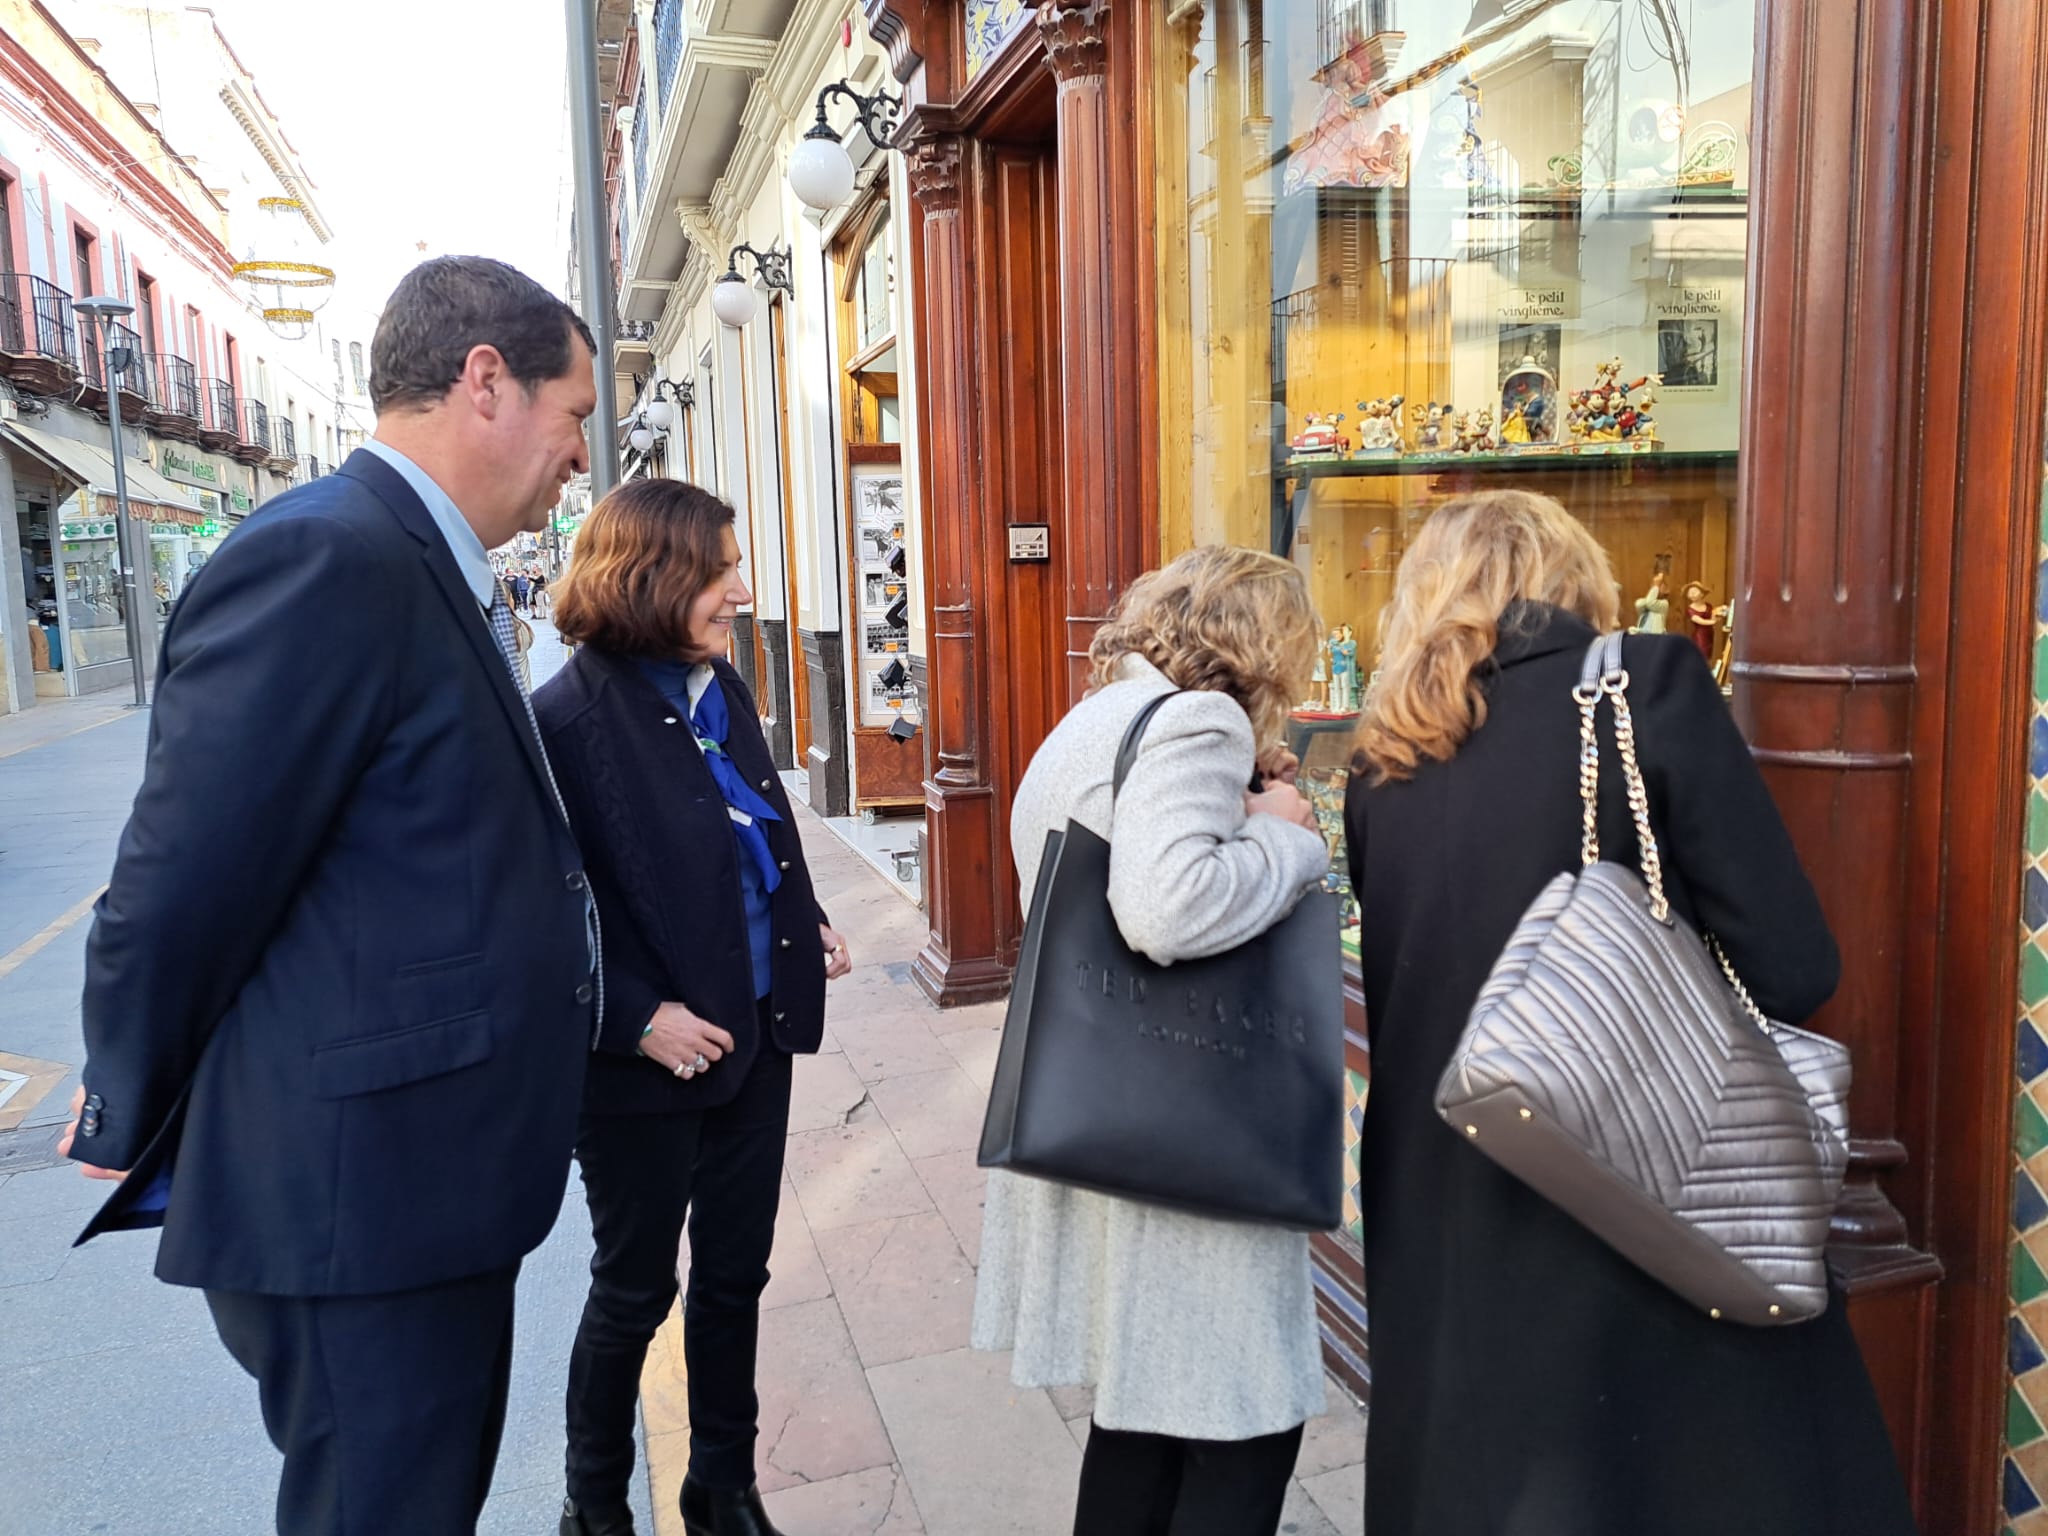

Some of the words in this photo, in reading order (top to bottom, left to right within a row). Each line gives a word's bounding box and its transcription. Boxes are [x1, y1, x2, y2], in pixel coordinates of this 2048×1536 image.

[1525, 291, 1536, 303] le
[1684, 289, 1695, 301] le
[1075, 961, 1147, 1004] TED
